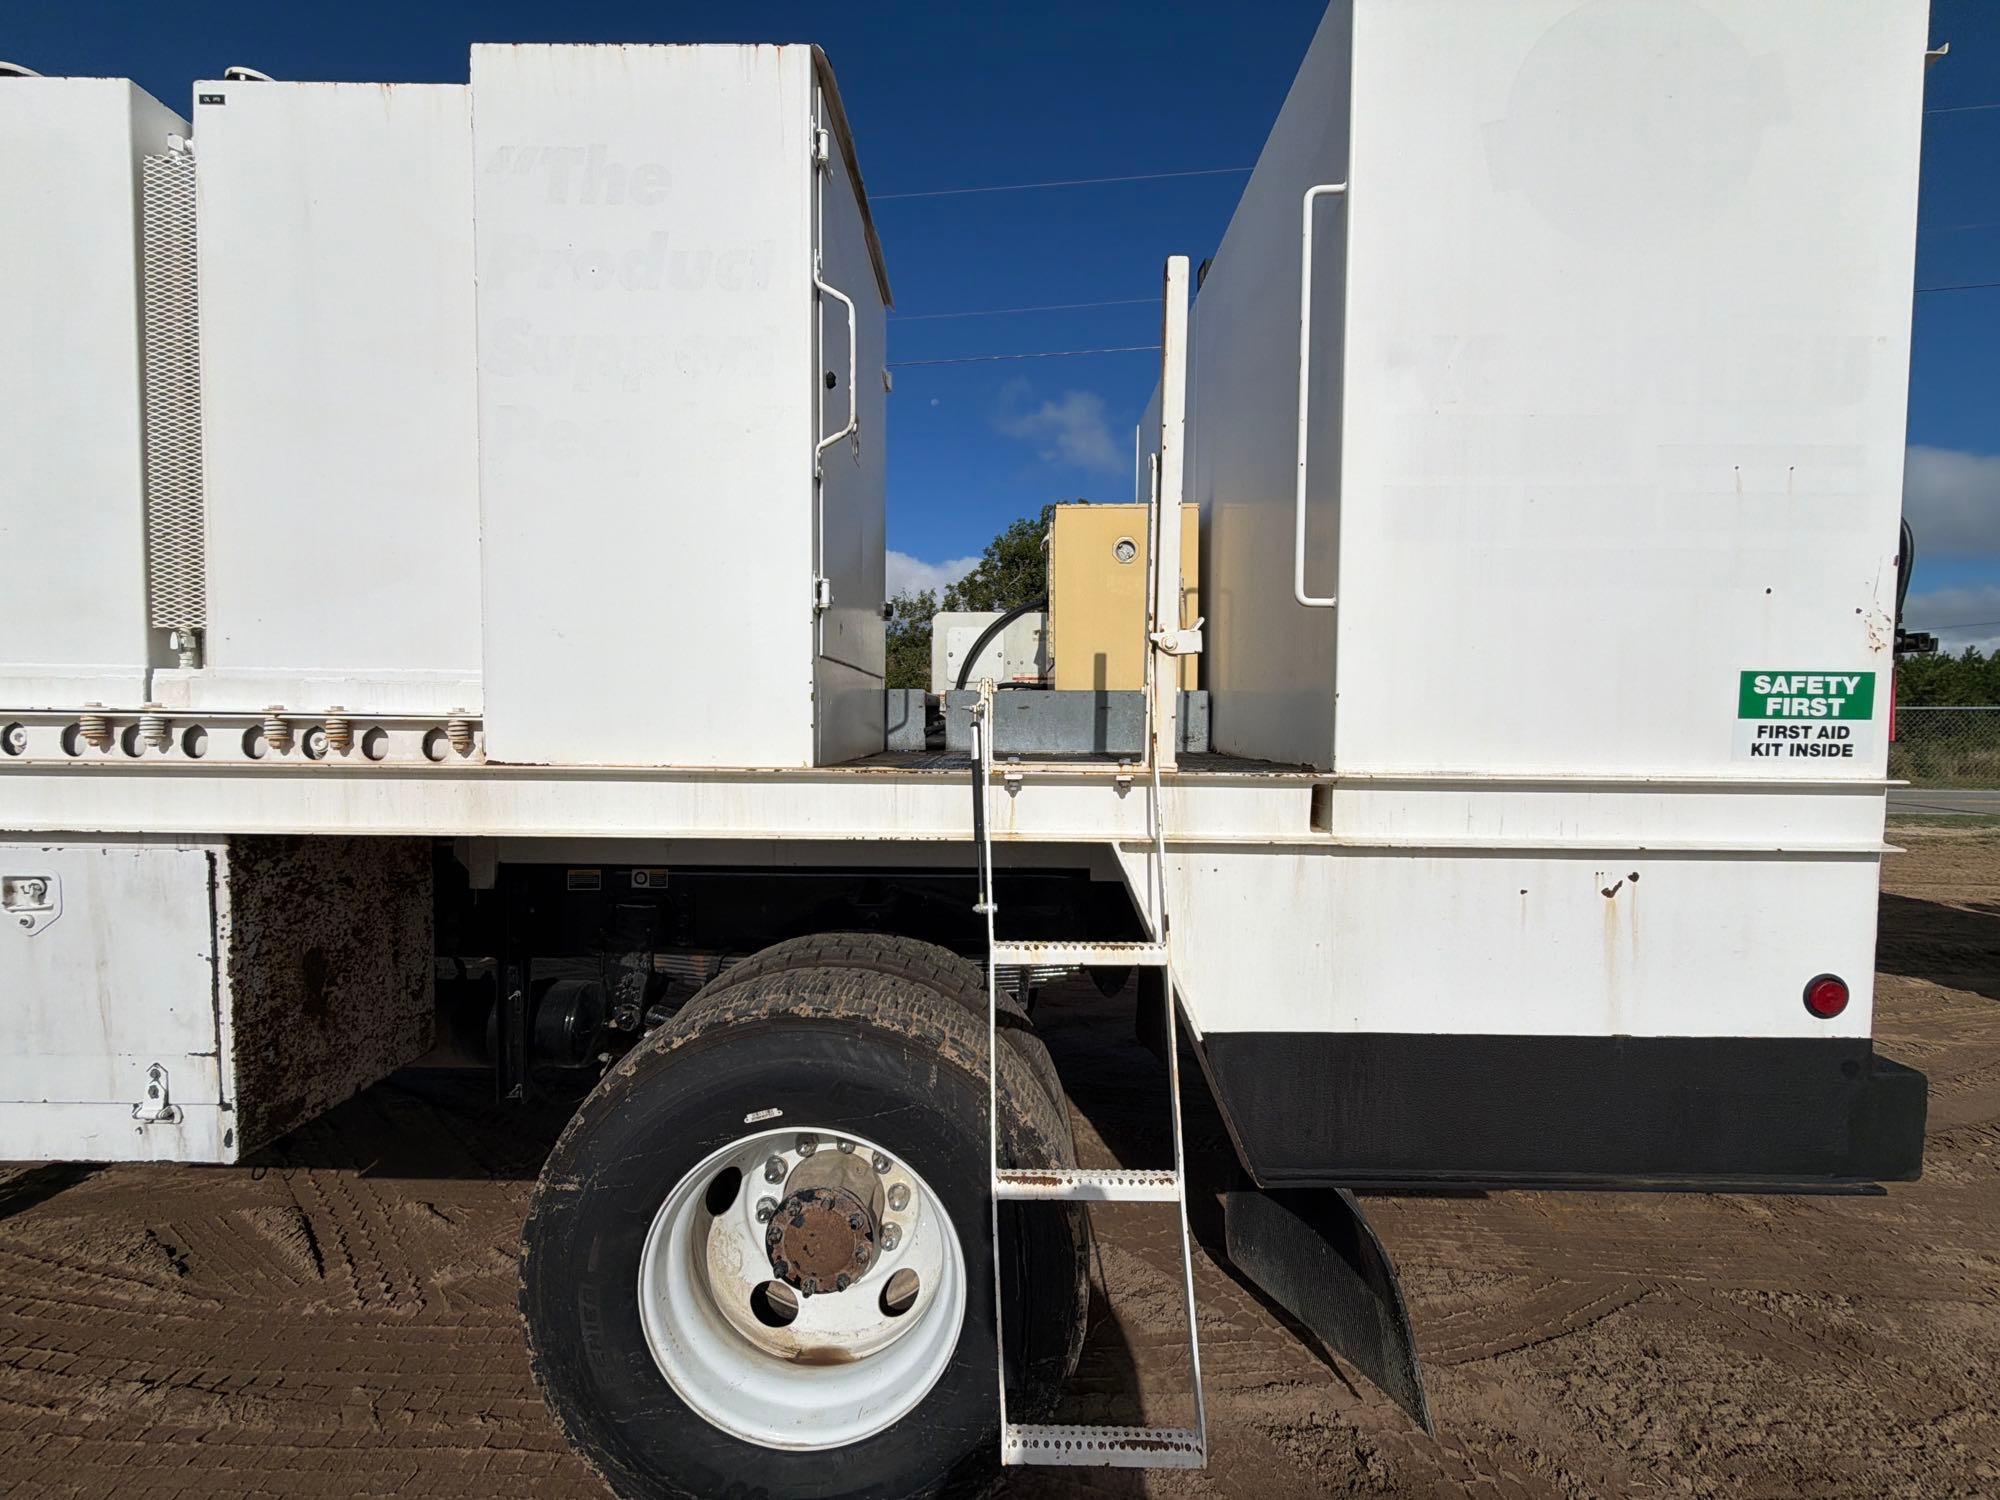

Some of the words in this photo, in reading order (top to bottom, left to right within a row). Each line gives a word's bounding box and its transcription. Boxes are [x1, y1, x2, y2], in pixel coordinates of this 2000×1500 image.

[1753, 675, 1861, 695] SAFETY
[1766, 697, 1845, 716] FIRST
[1757, 725, 1812, 739] FIRST
[1817, 725, 1850, 739] AID
[1750, 742, 1783, 757] KIT
[1789, 743, 1854, 757] INSIDE
